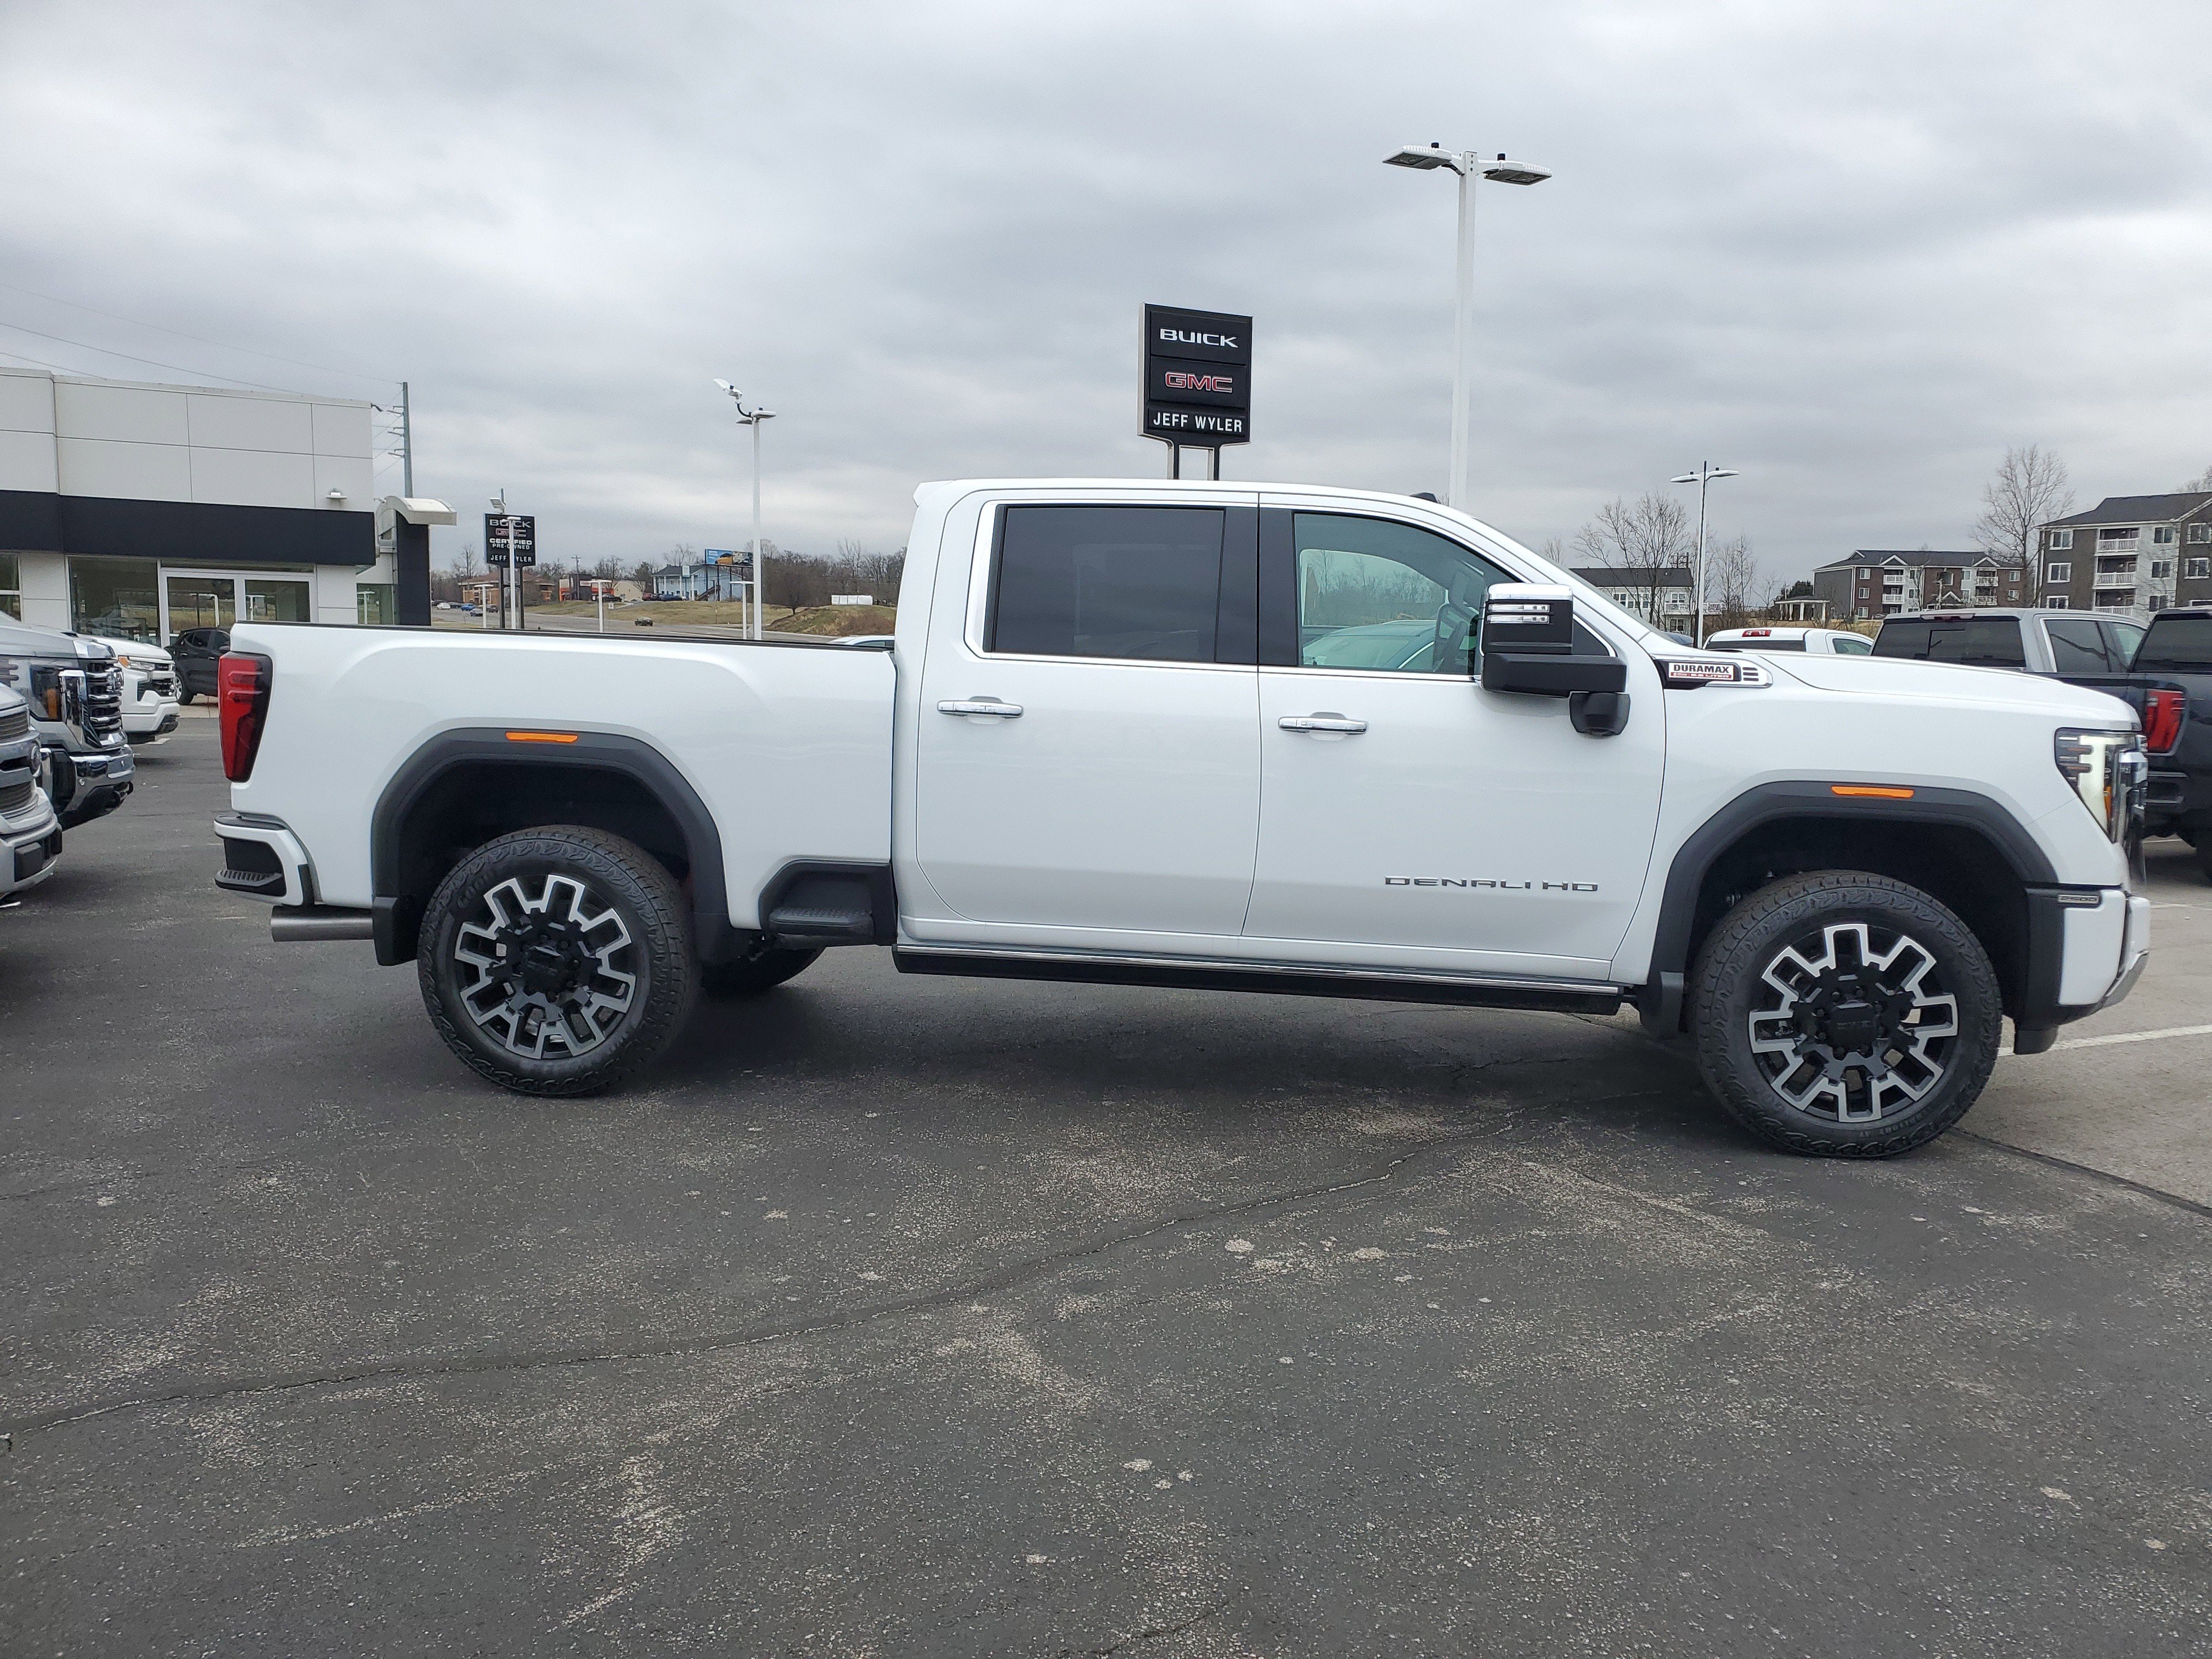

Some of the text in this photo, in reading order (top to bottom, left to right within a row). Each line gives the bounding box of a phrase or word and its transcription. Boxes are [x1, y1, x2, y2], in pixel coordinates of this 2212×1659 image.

[1160, 328, 1239, 348] BUICK
[1165, 371, 1232, 393] GMC
[1153, 412, 1242, 432] JEFF WYLER
[489, 518, 532, 528] BUCK
[1673, 664, 1729, 673] DURAMAX
[1385, 876, 1599, 892] DENALI HD
